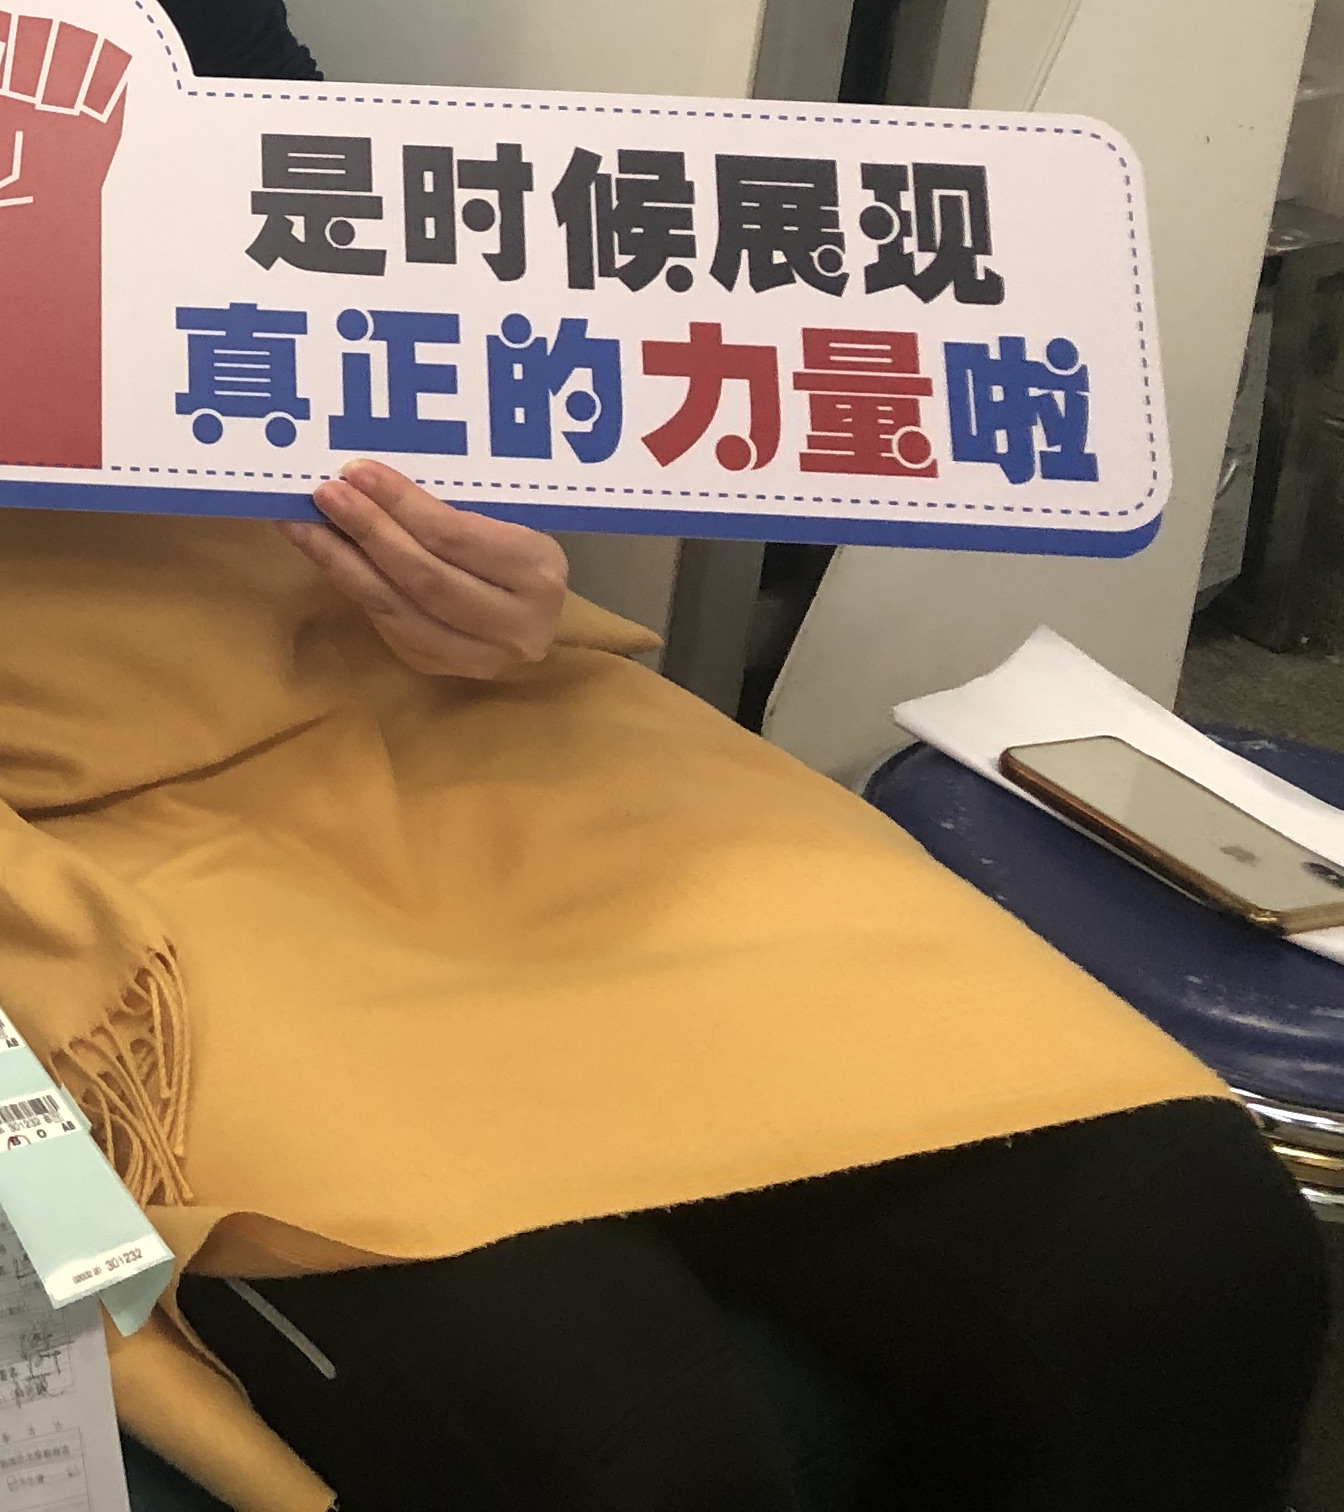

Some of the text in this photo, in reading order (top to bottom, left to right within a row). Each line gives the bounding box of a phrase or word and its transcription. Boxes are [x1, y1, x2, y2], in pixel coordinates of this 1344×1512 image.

[245, 132, 1005, 306] 是时候展现
[174, 301, 1100, 486] 真正的力量啦
[8, 1118, 41, 1133] 301232
[36, 1128, 47, 1139] O
[61, 1120, 76, 1133] AB
[105, 1248, 143, 1272] 301232
